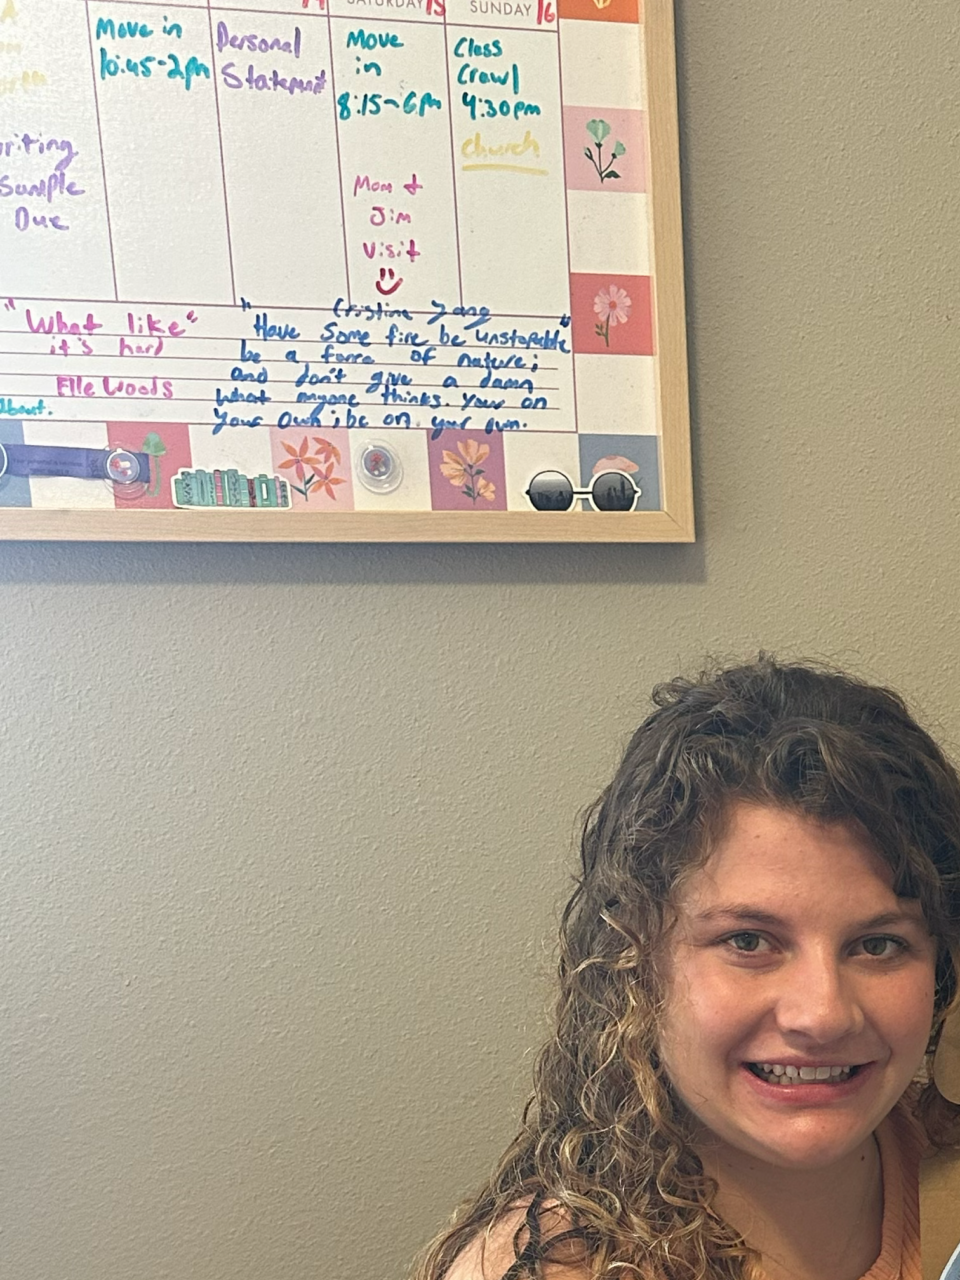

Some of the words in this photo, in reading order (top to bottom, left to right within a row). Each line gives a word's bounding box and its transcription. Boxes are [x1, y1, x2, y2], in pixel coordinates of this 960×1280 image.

[470, 0, 532, 16] SUNDAY
[97, 17, 153, 40] Move
[163, 15, 183, 39] in
[216, 21, 301, 58] Personal
[347, 29, 404, 50] Move
[453, 37, 503, 58] Class
[356, 56, 381, 76] in
[457, 63, 519, 94] Crawl
[462, 92, 541, 120] 4:30pm
[0, 132, 79, 172] riting
[354, 175, 393, 197] Mom
[15, 206, 70, 232] Due
[369, 206, 412, 227] Jim
[119, 336, 164, 357] hard
[385, 325, 429, 348] fire
[439, 324, 467, 347] be
[241, 340, 262, 363] be
[285, 350, 298, 363] a
[321, 345, 375, 364] force
[410, 347, 436, 365] of
[56, 375, 95, 398] Elle
[103, 375, 173, 400] Woods
[231, 366, 268, 384] and
[295, 363, 346, 387] don't
[366, 370, 413, 394] give
[442, 375, 459, 388] a
[479, 369, 534, 394] damn
[521, 397, 547, 410] on
[346, 408, 369, 429] be
